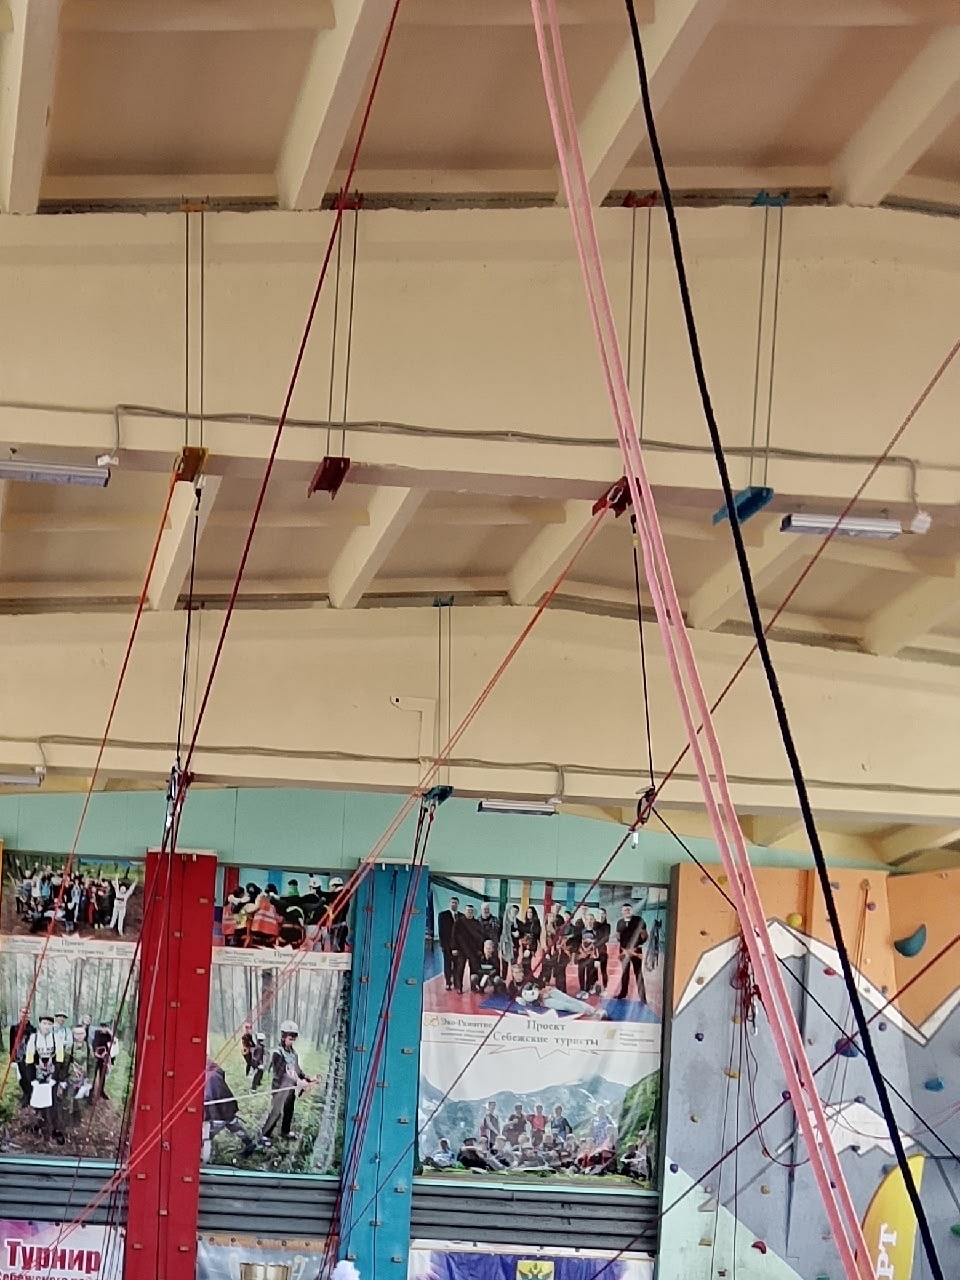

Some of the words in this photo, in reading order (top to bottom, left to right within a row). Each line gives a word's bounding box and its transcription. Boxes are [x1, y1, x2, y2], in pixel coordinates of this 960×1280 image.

[527, 1020, 566, 1032] Проект
[493, 1033, 548, 1044] Себежские
[554, 1036, 599, 1047] туристы
[5, 1239, 101, 1275] Турнир
